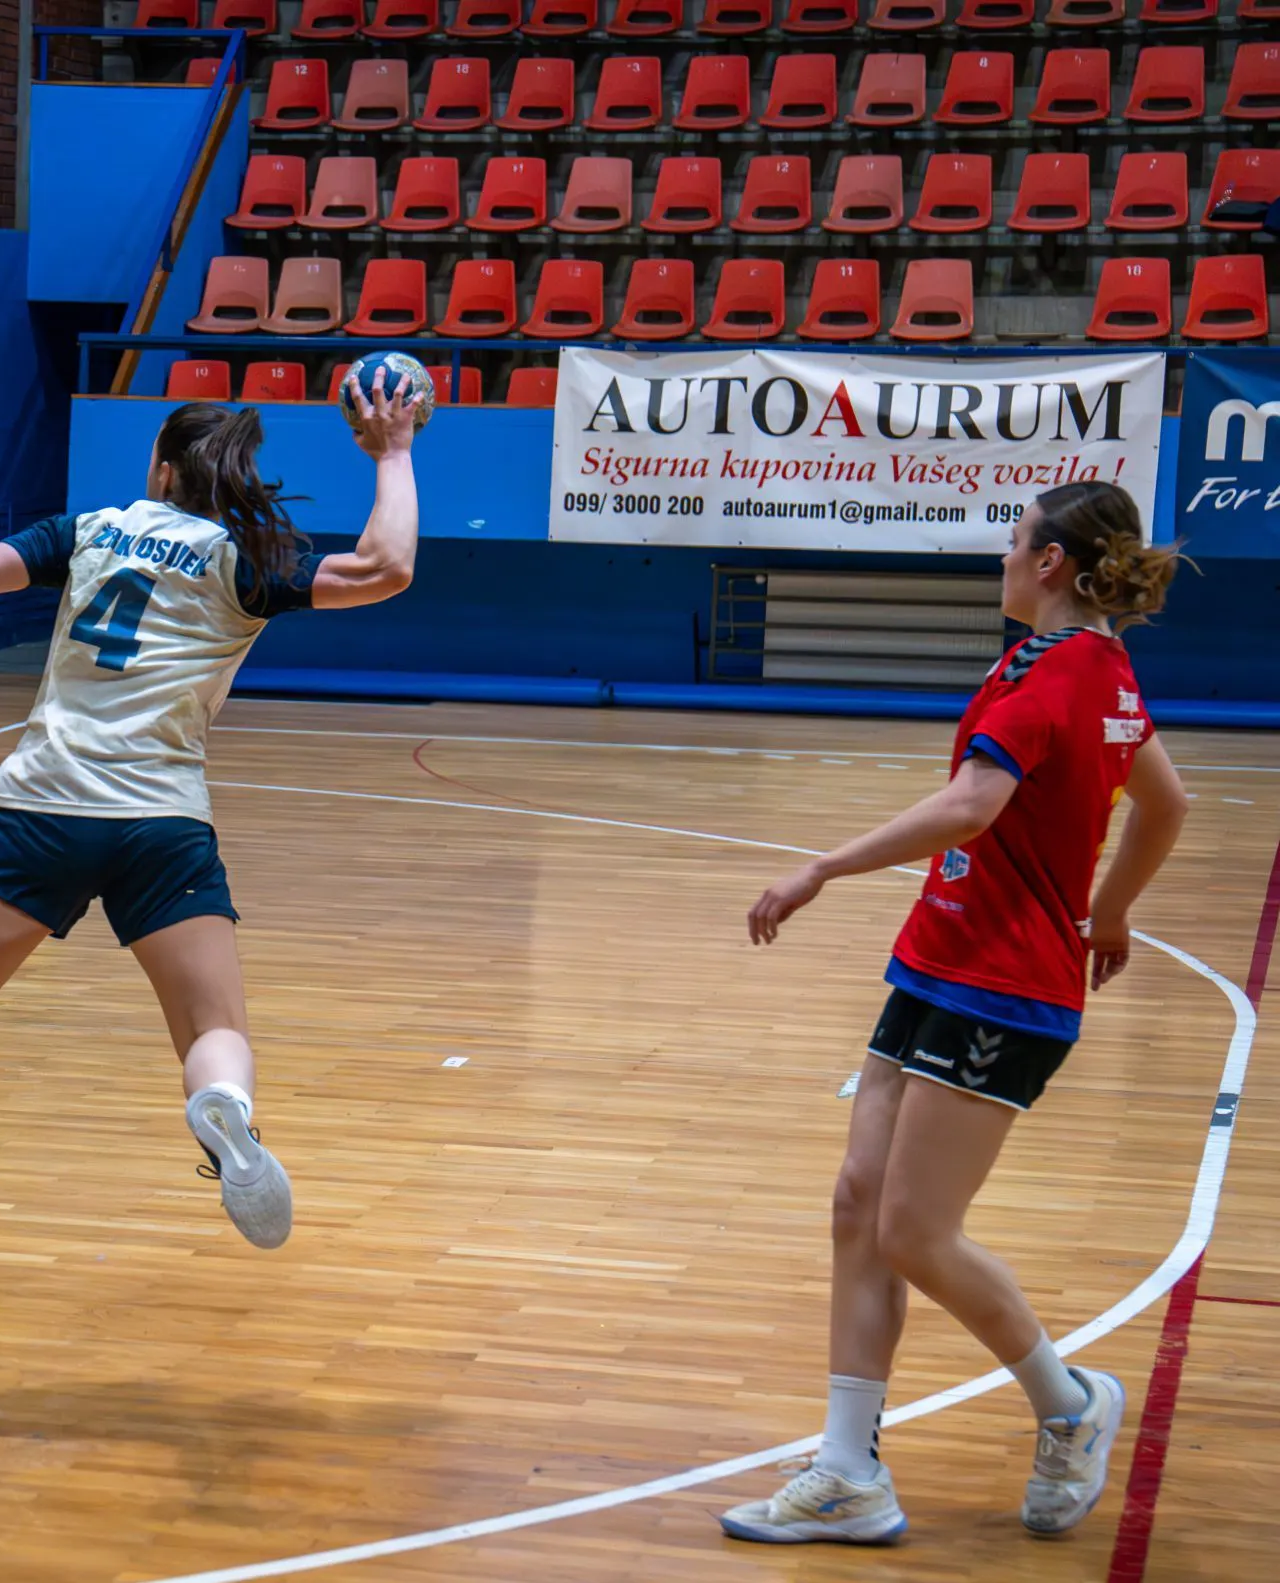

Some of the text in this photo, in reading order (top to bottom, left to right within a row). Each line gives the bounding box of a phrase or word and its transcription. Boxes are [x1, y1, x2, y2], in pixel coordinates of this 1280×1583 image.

[294, 64, 309, 76] 12
[580, 446, 710, 487] Sigurna
[719, 448, 877, 489] kupovina
[888, 453, 985, 495] Vašeg
[992, 455, 1101, 486] vozila
[563, 492, 608, 515] 099/
[612, 493, 661, 515] 3000
[667, 495, 704, 517] 200
[722, 497, 966, 525] autoaurum1@gmail.com
[1185, 476, 1262, 513] For
[68, 567, 157, 672] 4
